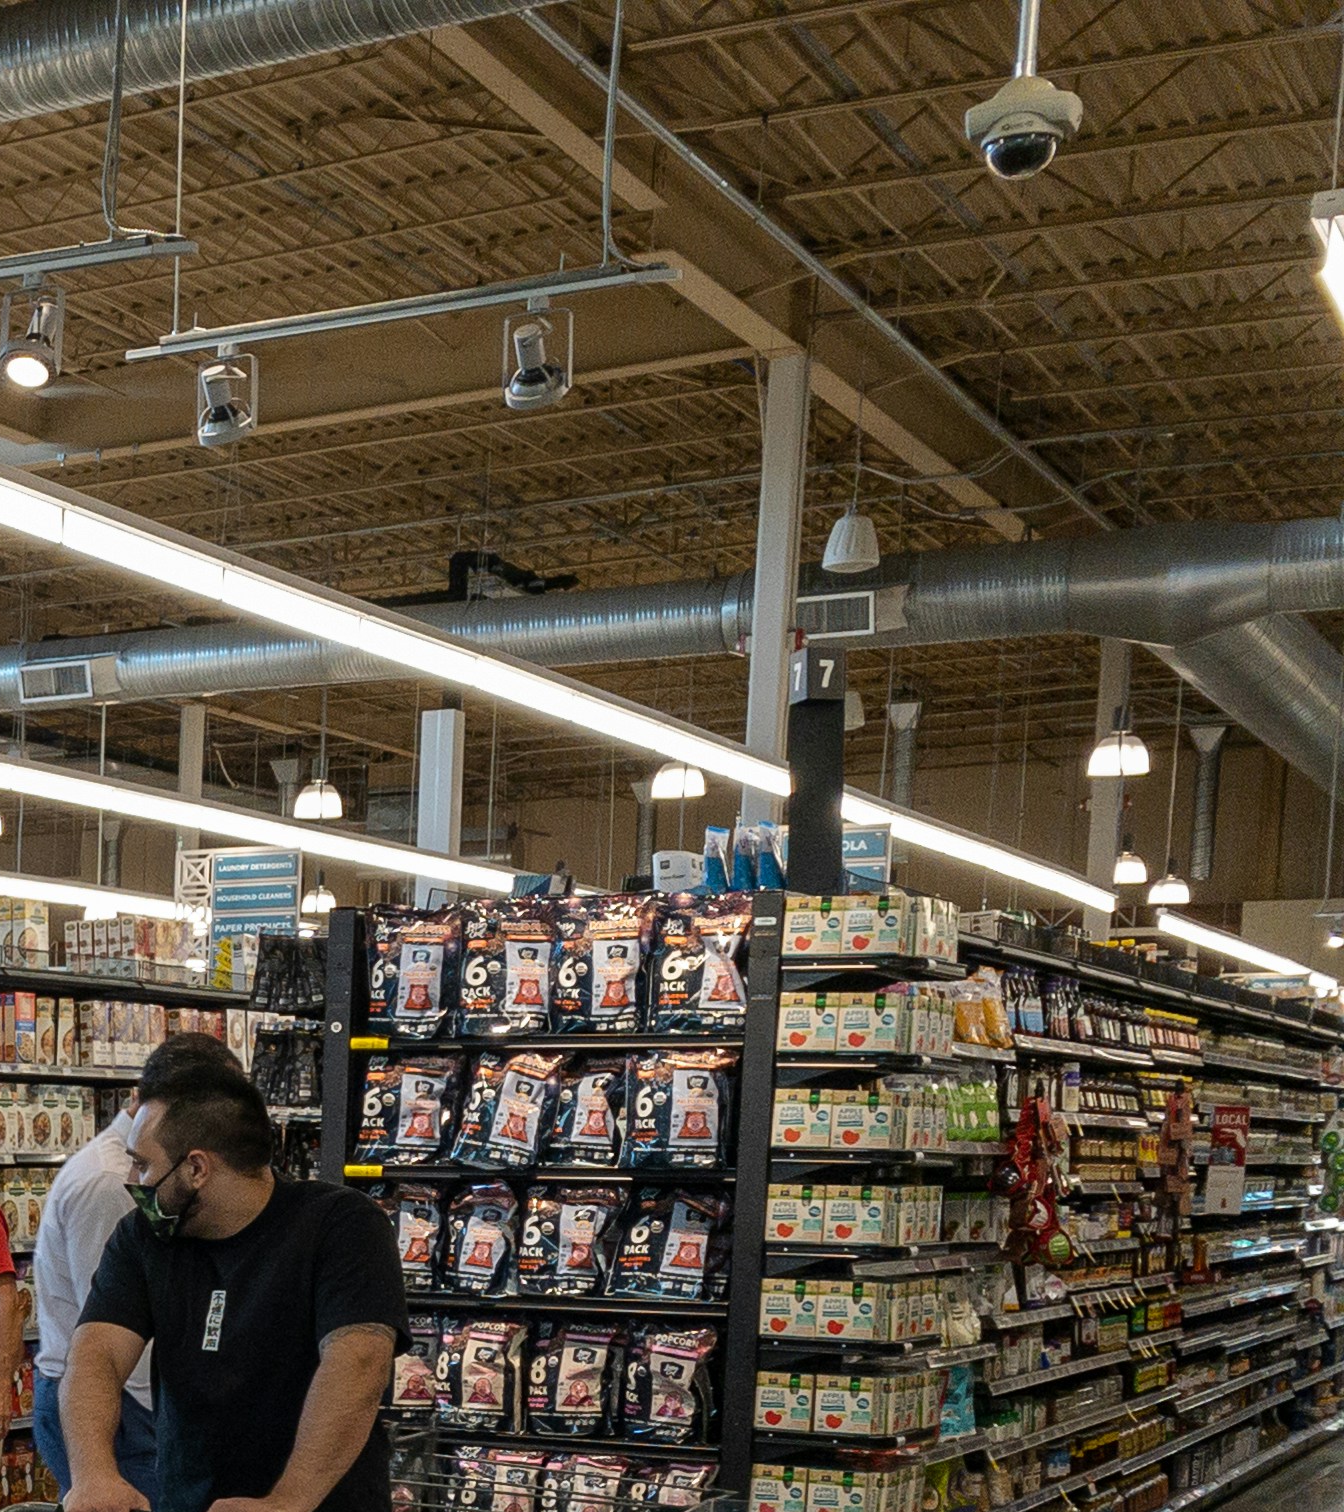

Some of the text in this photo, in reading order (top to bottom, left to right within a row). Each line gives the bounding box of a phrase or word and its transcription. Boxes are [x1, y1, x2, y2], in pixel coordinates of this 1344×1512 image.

[819, 660, 834, 688] 7
[218, 861, 293, 872] LAUNDRY DETERGENTS
[217, 892, 292, 902] HOUSEHOLD CLEANERS
[214, 924, 242, 932] PAPER
[371, 958, 384, 989] 6
[466, 957, 487, 986] 6
[558, 957, 577, 987] 6
[662, 951, 684, 980] 6
[462, 986, 491, 999] PACK
[362, 1088, 382, 1116] 6
[635, 1087, 654, 1117] 6
[1215, 1113, 1249, 1125] LOCAL
[523, 1216, 541, 1245] 6
[630, 1216, 649, 1244] 6
[624, 1244, 649, 1255] PACK
[655, 1334, 701, 1349] POPCORN
[436, 1351, 450, 1380] 8
[531, 1356, 547, 1384] 8
[528, 1385, 548, 1396] PACK
